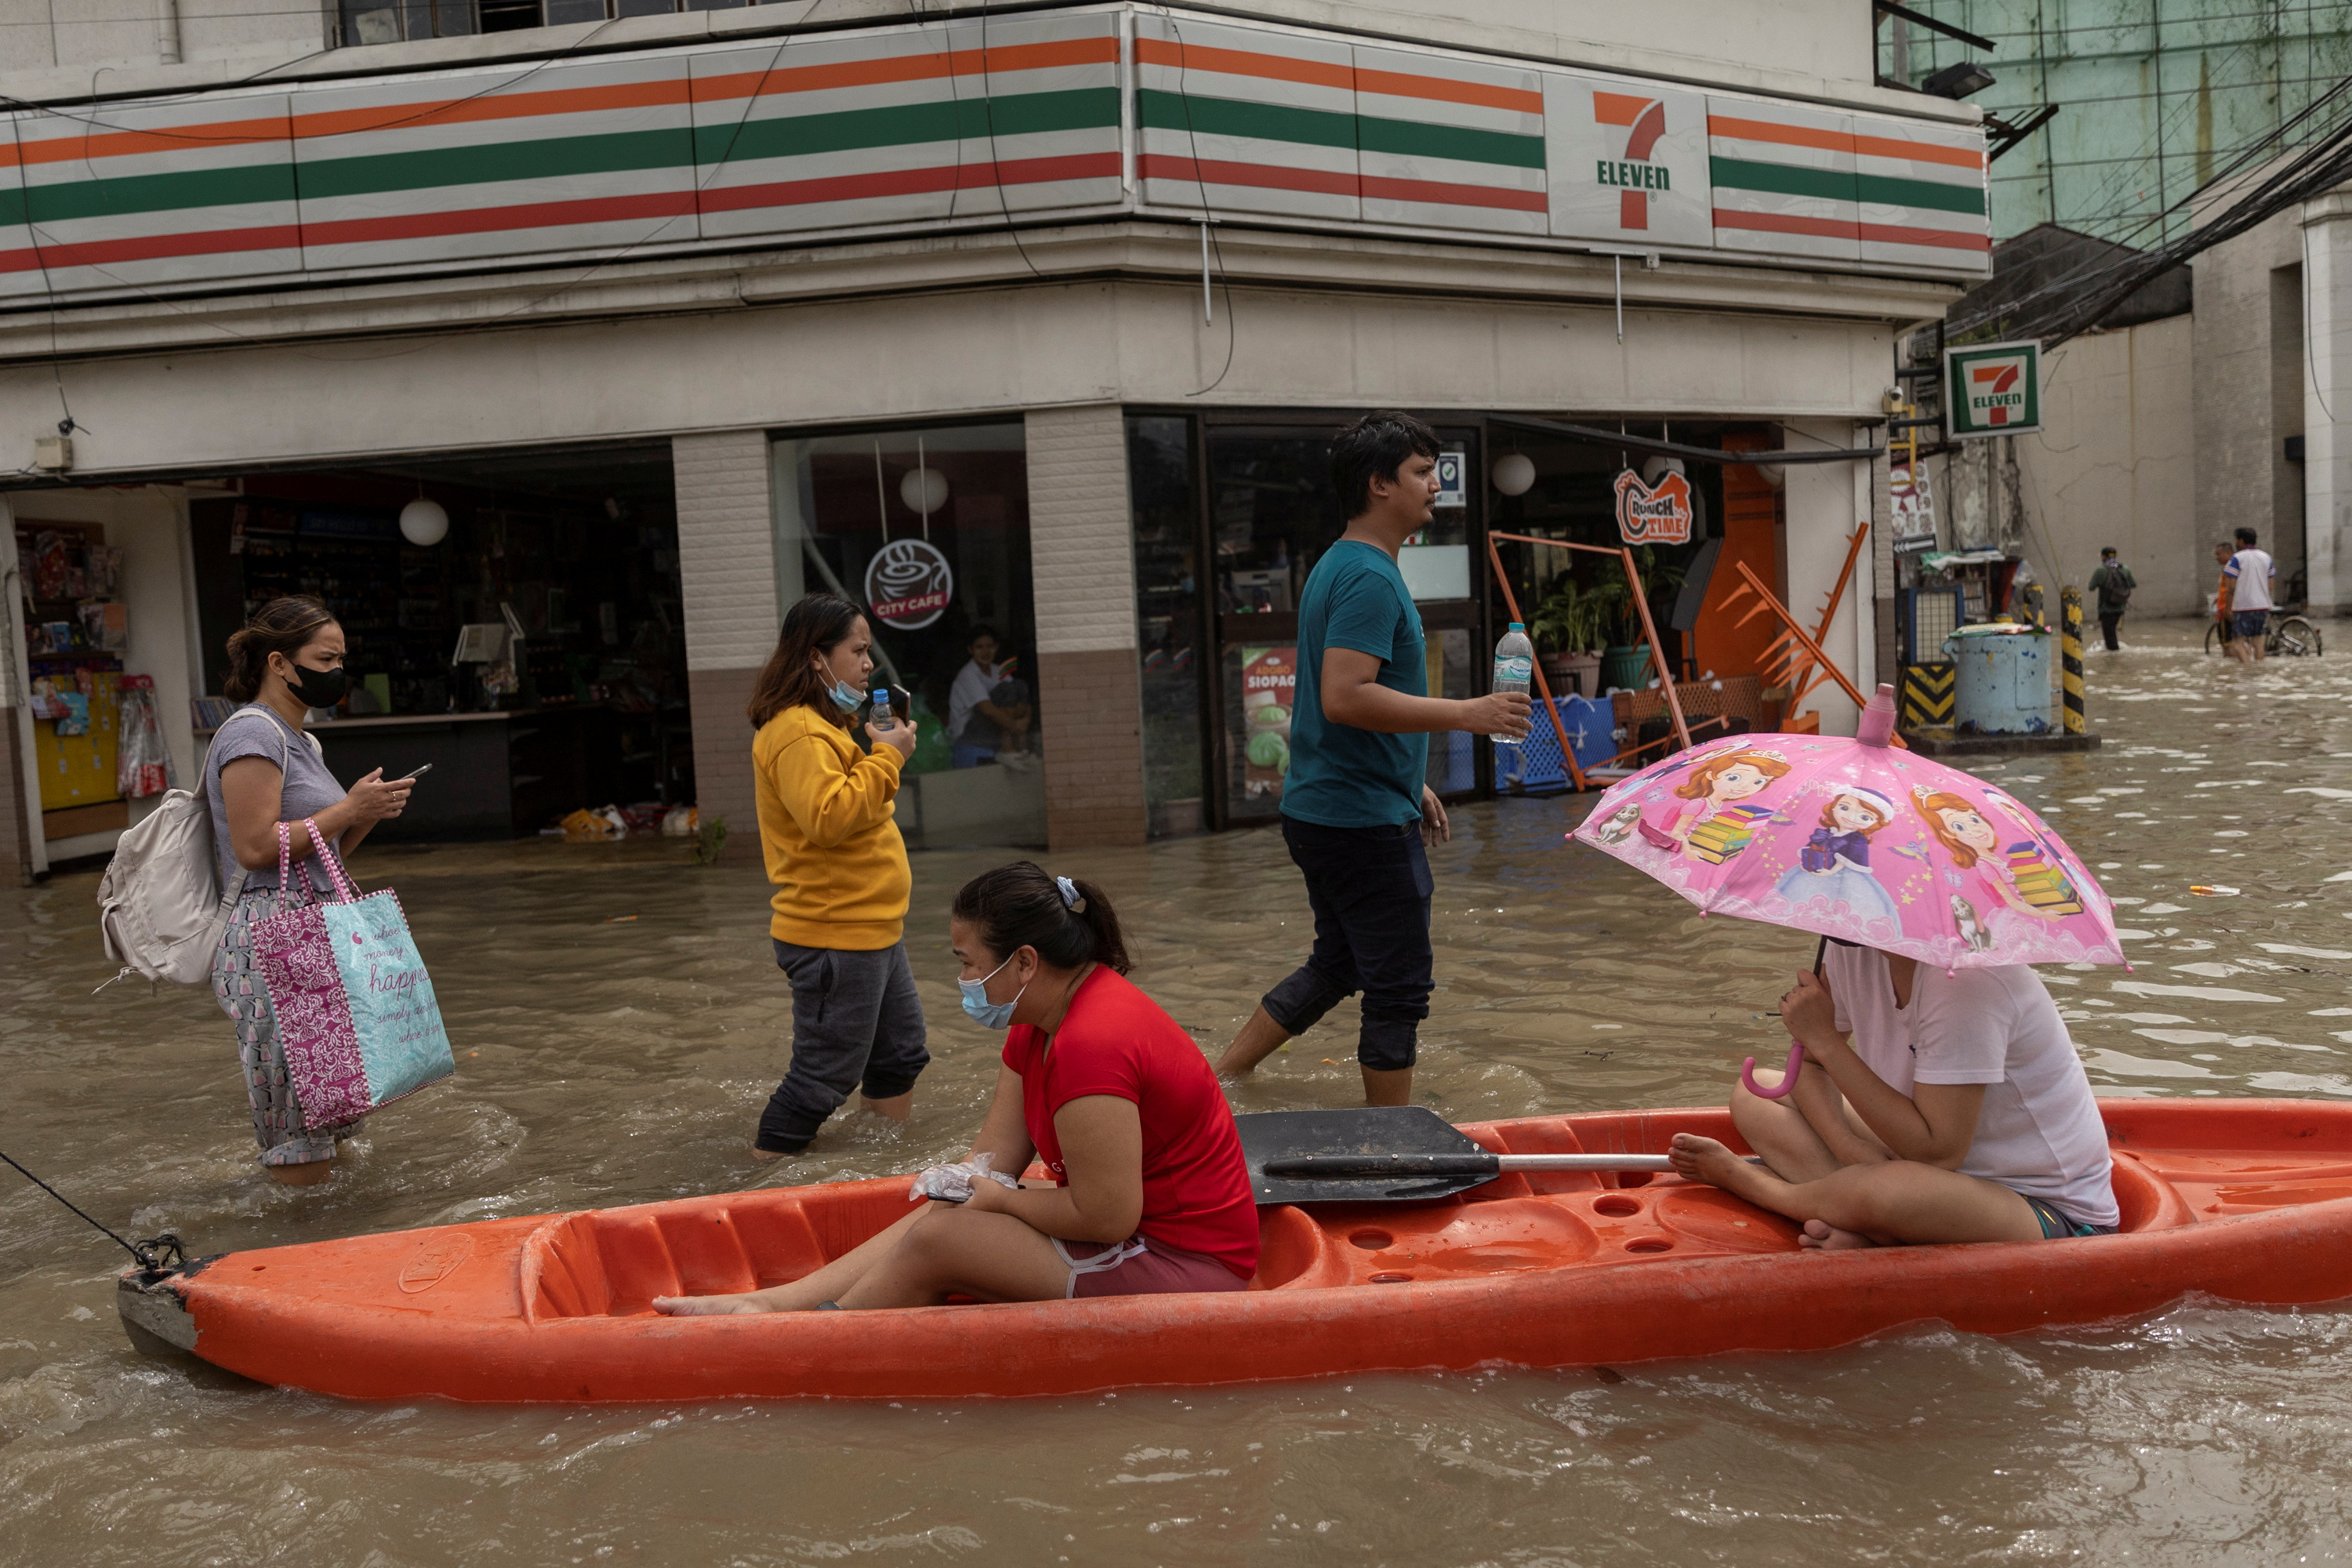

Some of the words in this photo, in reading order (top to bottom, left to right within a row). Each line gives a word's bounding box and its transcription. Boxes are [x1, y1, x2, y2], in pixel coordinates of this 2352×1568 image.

[1623, 483, 1674, 535] CRUNCH
[1647, 517, 1683, 534] TIME
[877, 601, 906, 616] CITY
[907, 593, 943, 611] CAFE
[1247, 674, 1295, 688] SIOPAO
[365, 946, 404, 961] money
[376, 1003, 412, 1025] simply
[398, 1026, 423, 1044] where
